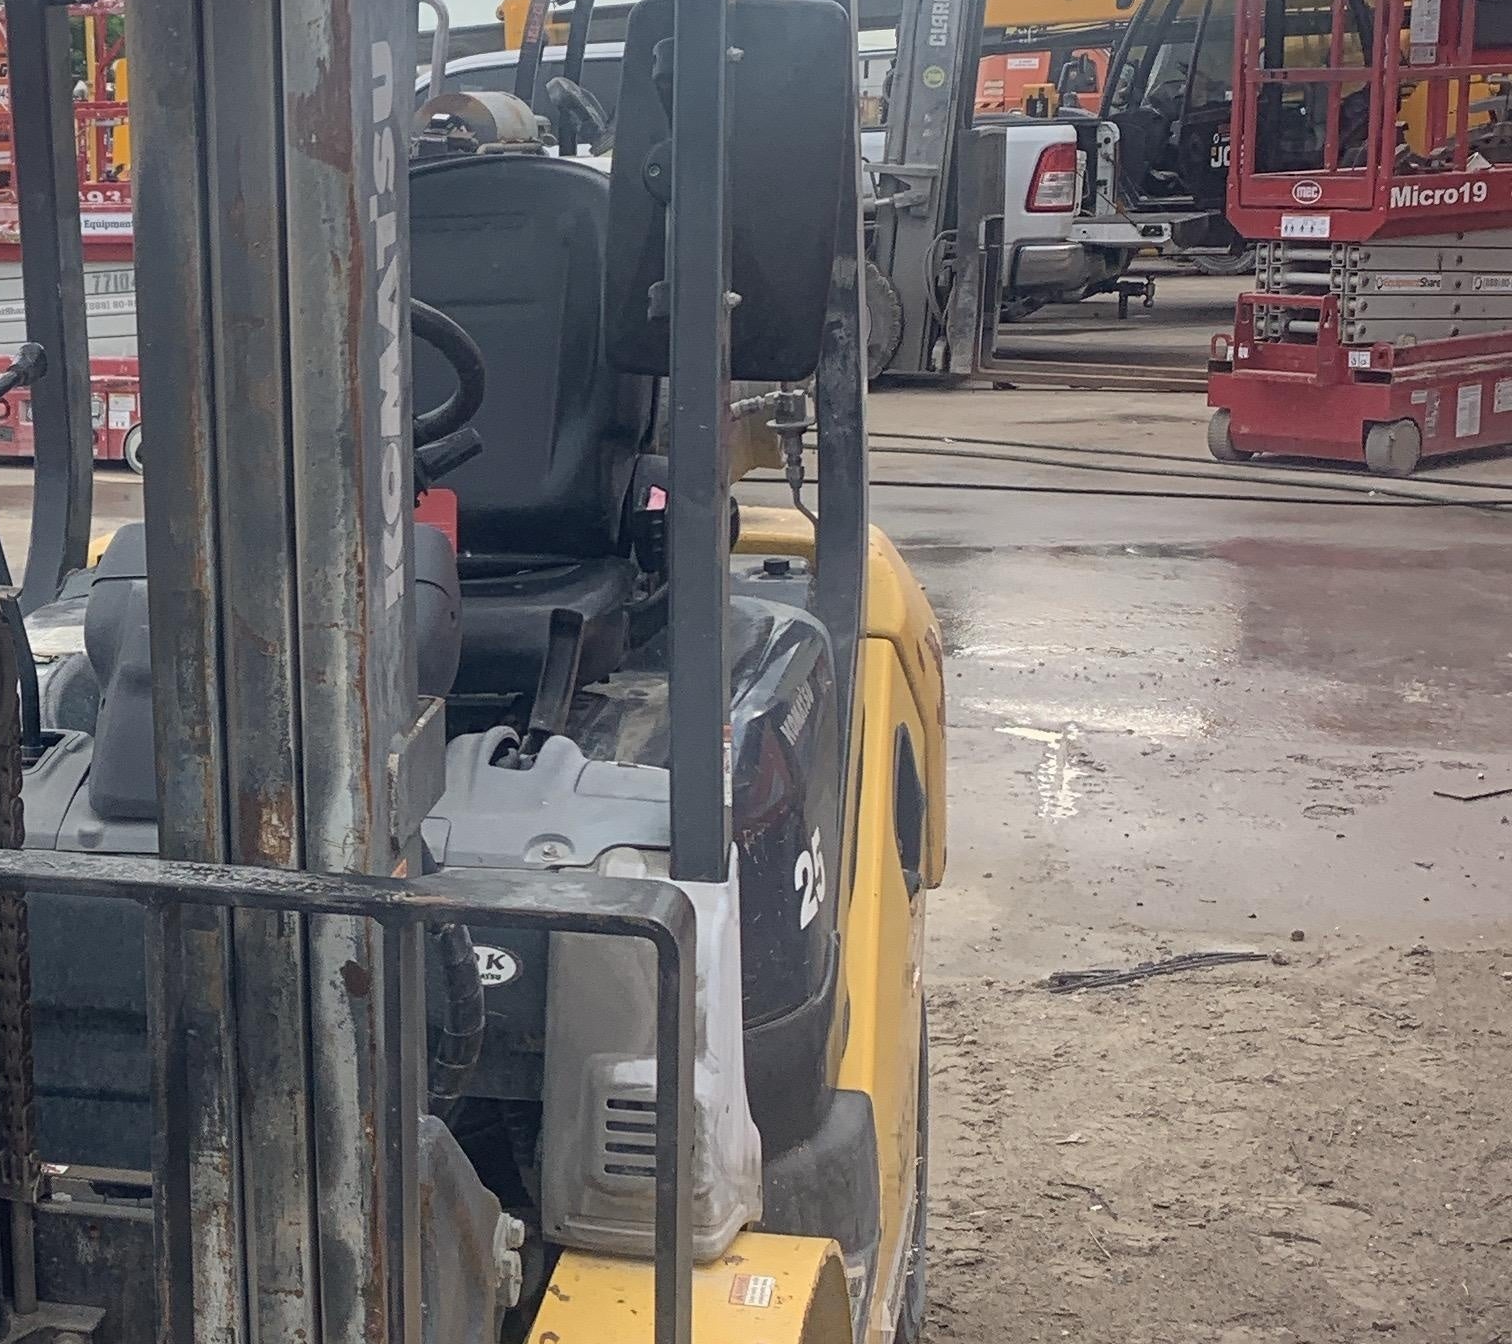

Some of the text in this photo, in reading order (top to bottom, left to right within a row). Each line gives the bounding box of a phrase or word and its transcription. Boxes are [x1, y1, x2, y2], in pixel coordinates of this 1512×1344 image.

[1390, 181, 1487, 208] Micro19
[369, 40, 405, 610] KOMATSU
[794, 823, 826, 930] 25
